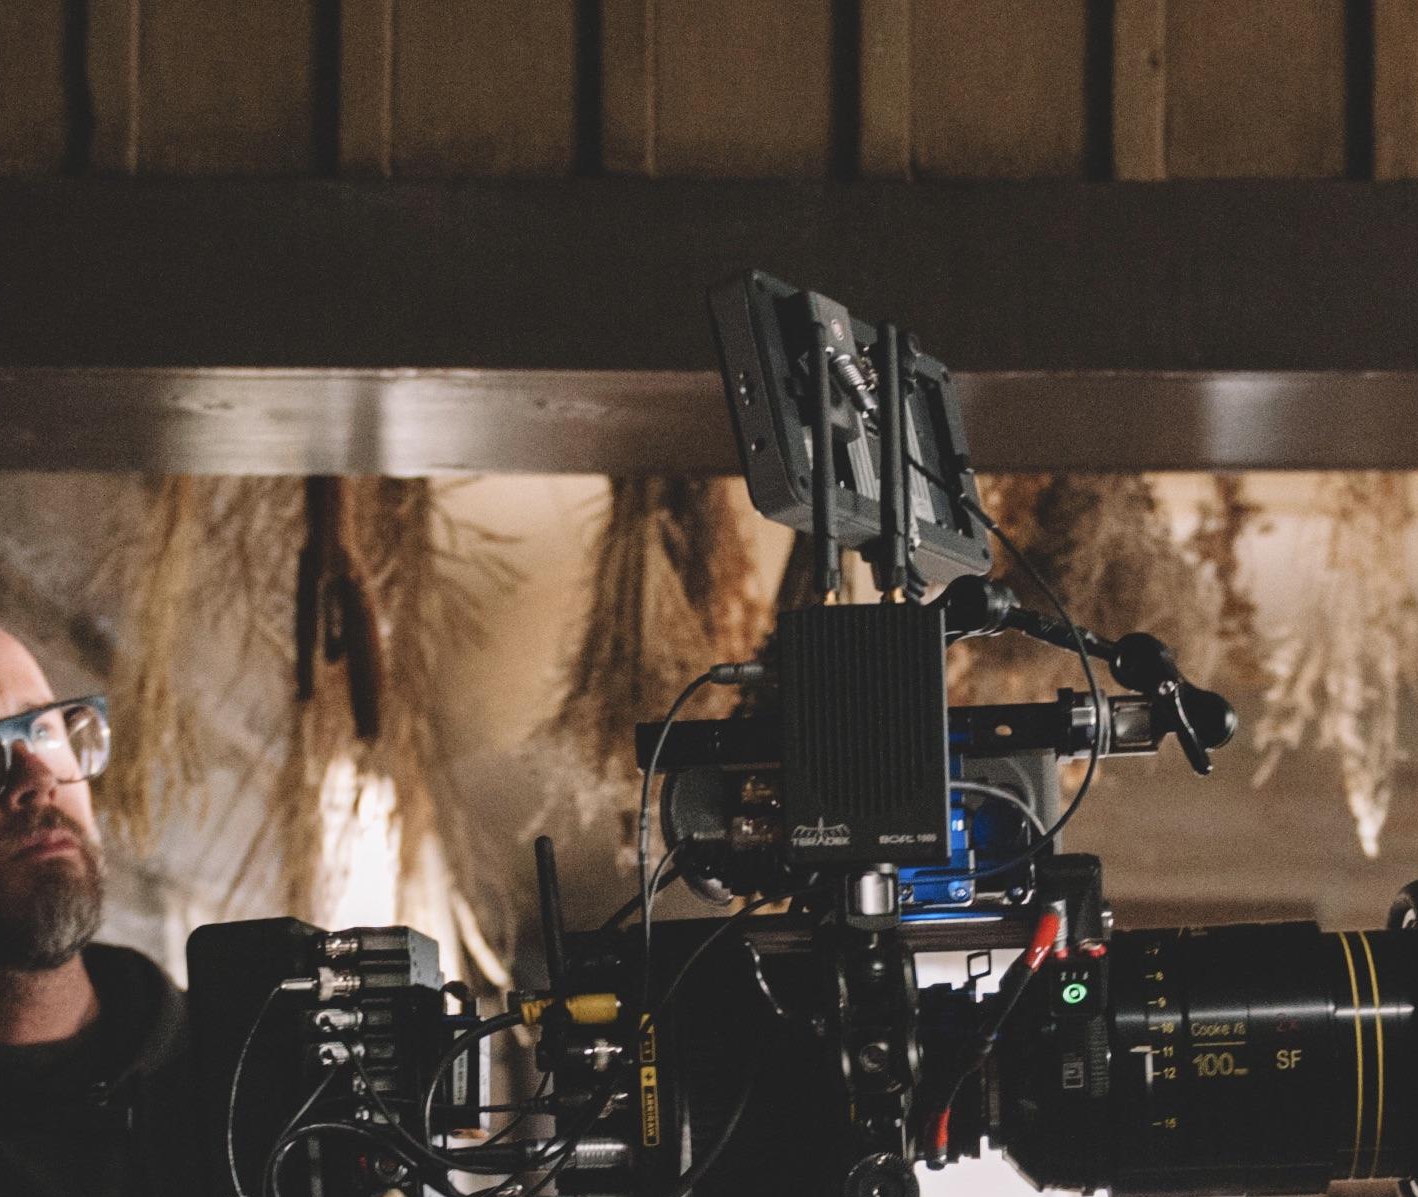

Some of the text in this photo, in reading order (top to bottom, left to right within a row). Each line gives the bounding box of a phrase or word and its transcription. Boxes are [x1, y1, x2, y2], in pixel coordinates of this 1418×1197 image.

[1190, 1023, 1230, 1037] Cooke
[1163, 1046, 1174, 1057] 11
[1276, 1050, 1302, 1070] SF
[1163, 1067, 1177, 1079] 12
